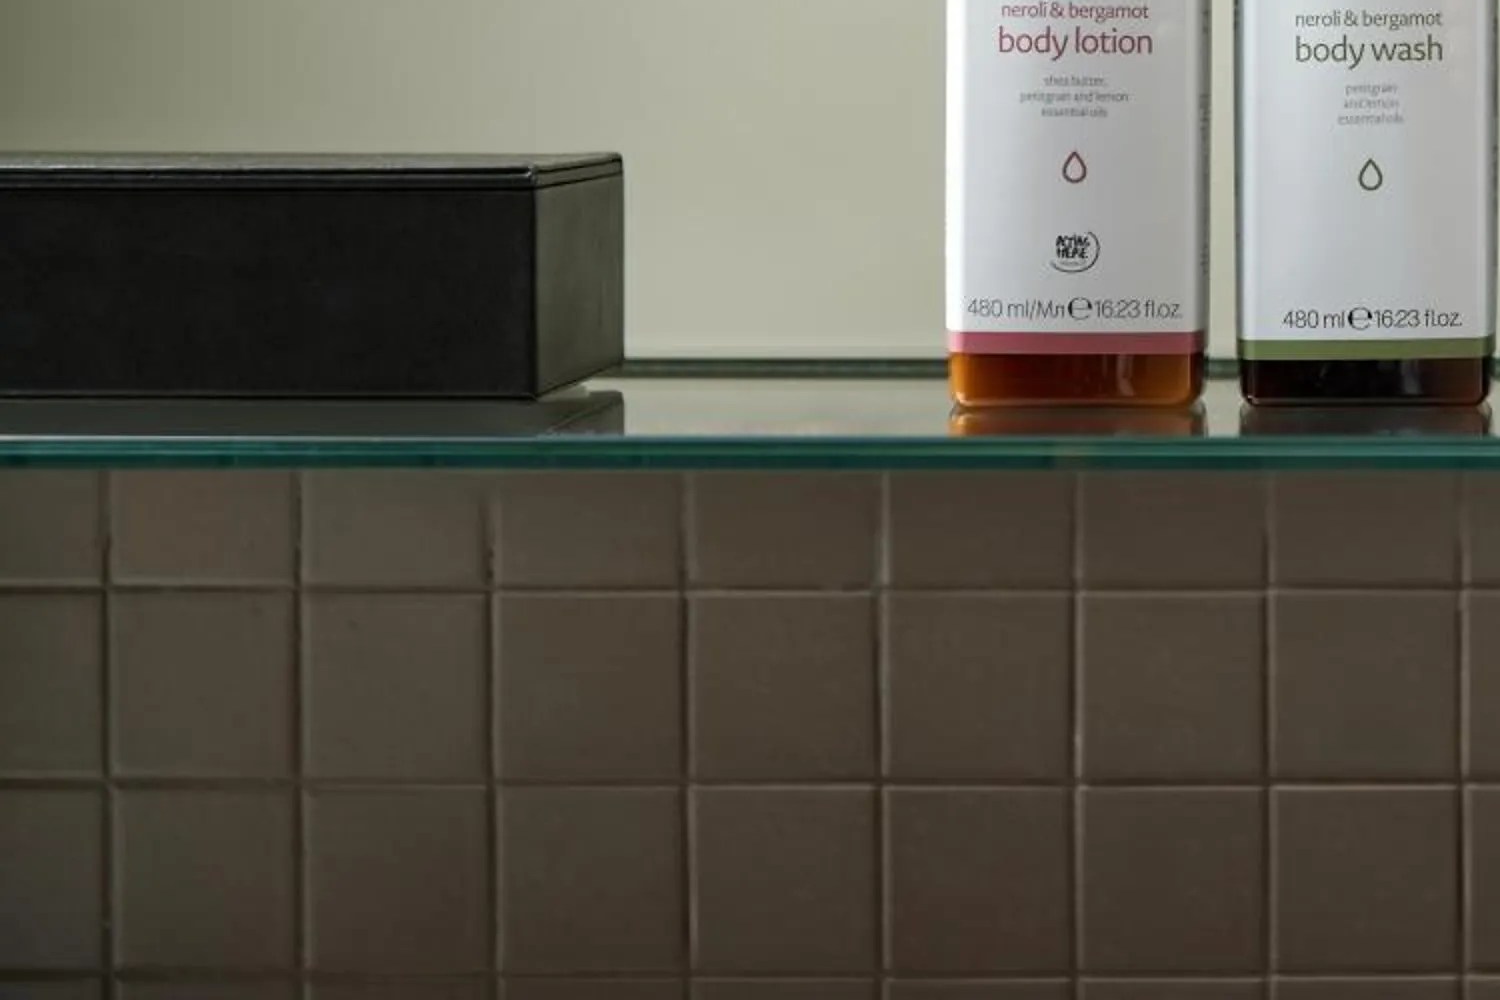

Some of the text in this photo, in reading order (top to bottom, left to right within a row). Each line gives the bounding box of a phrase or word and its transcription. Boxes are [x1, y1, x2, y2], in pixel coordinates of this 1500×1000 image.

[1001, 1, 1150, 23] neroli & bergamot
[1295, 10, 1444, 31] neroli & bergamot
[998, 25, 1154, 61] body lotion
[1295, 33, 1444, 70] body wash
[967, 299, 1003, 318] 480
[1282, 309, 1320, 328] 480
[1323, 309, 1345, 328] ml
